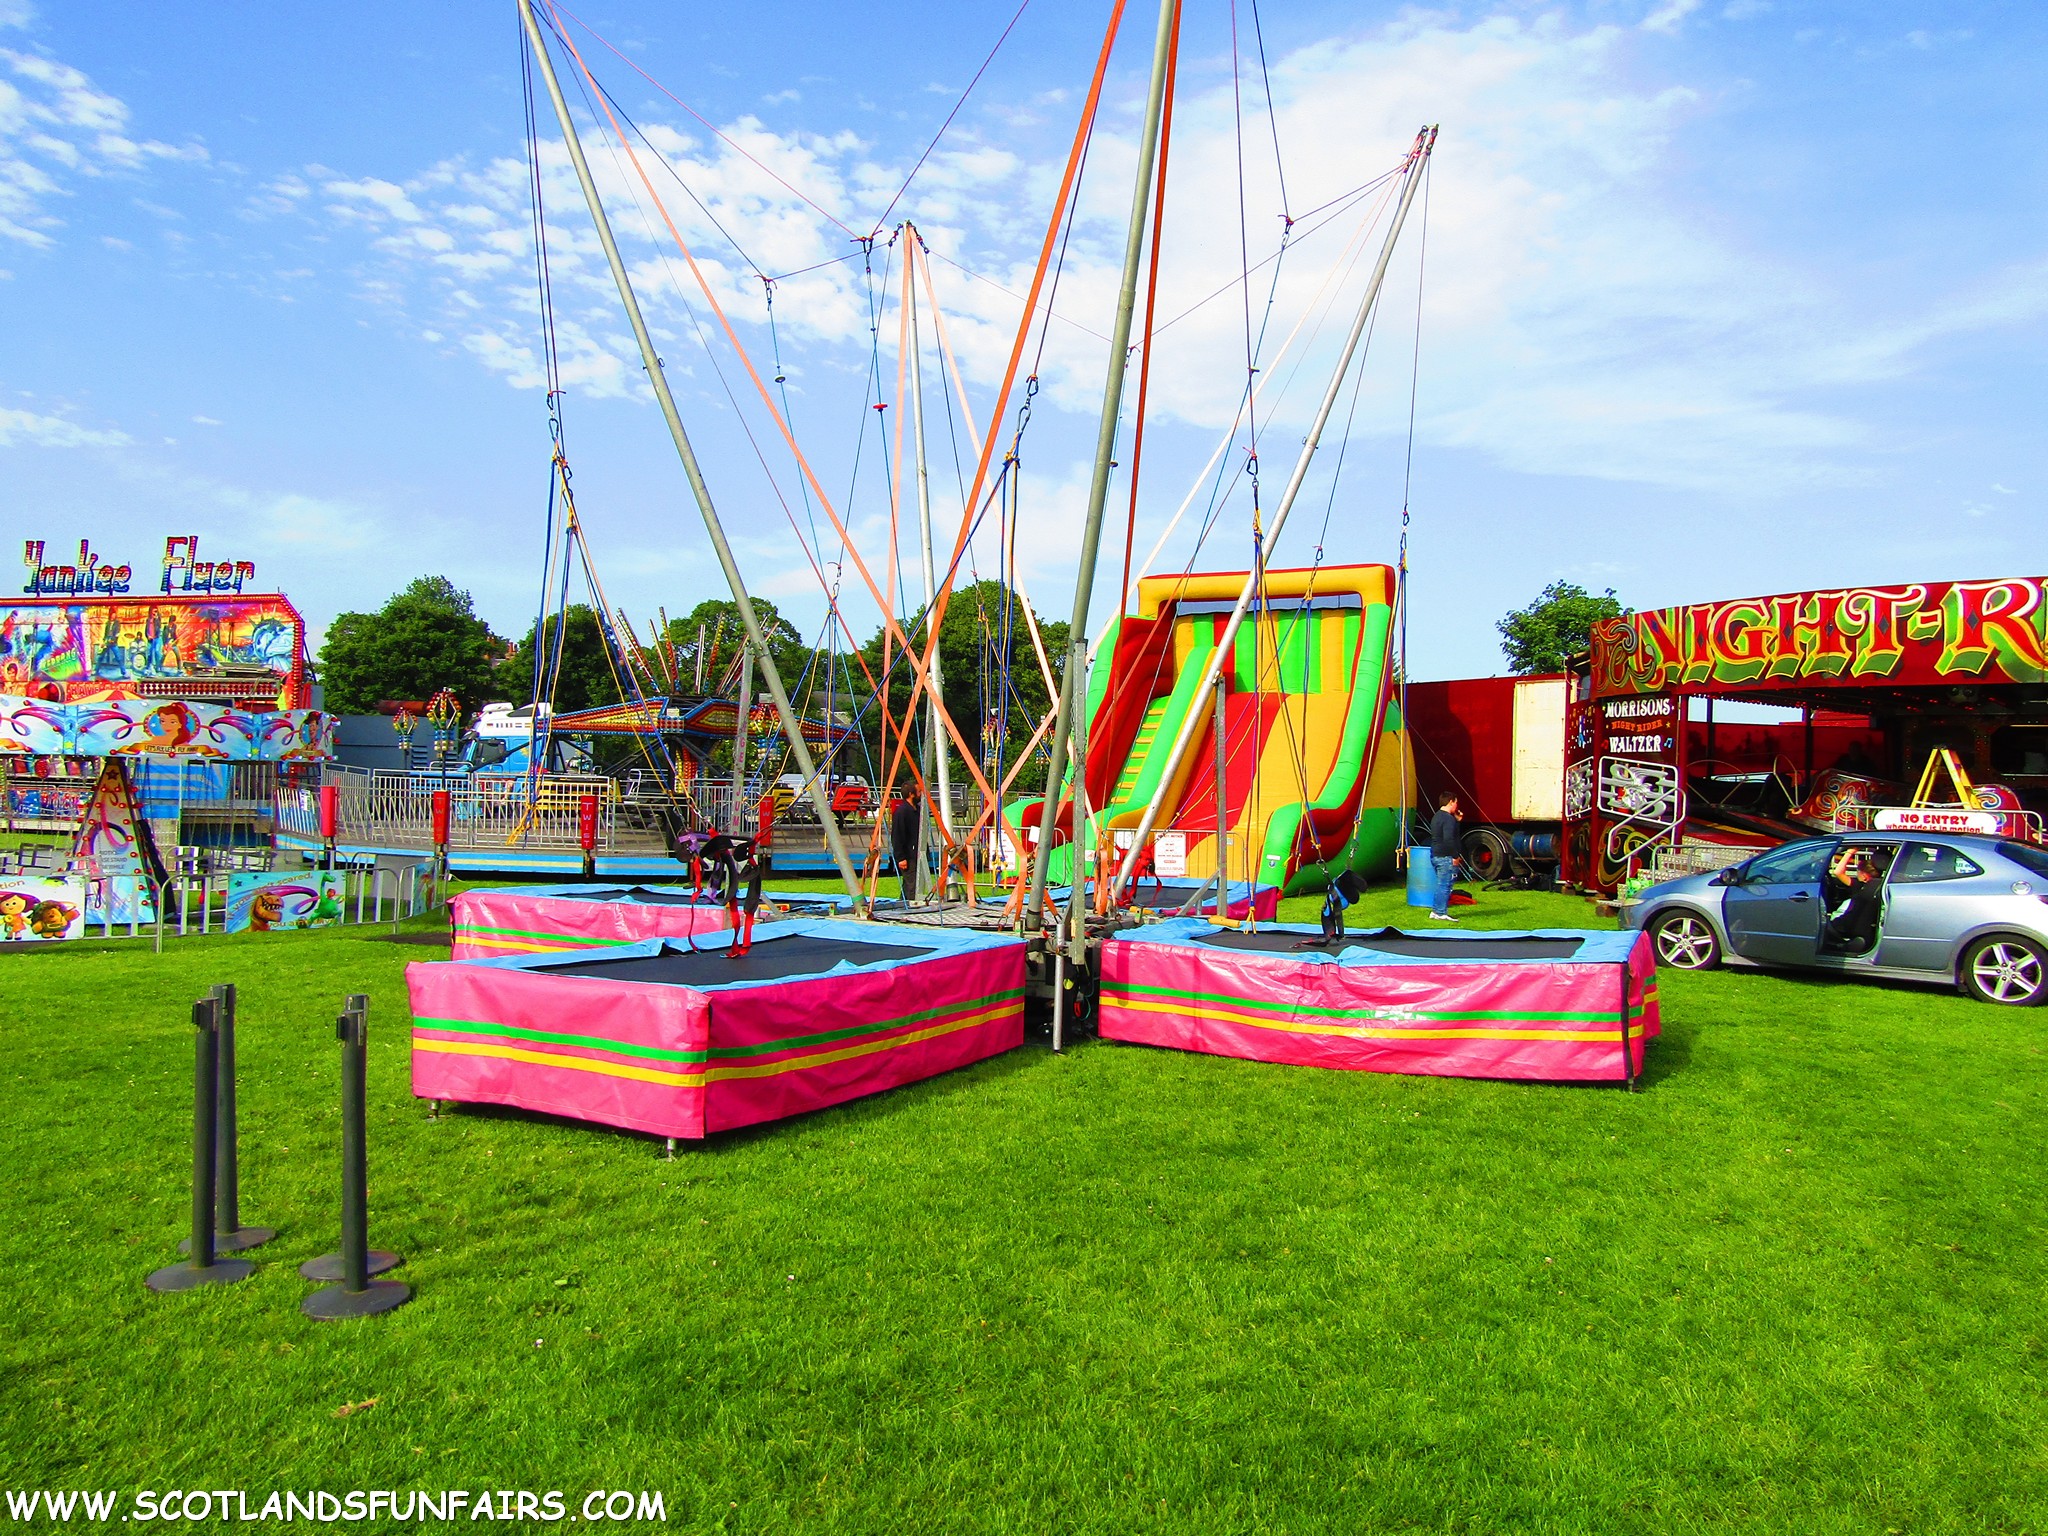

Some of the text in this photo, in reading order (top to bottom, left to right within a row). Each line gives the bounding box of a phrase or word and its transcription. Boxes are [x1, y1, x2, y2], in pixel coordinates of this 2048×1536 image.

[24, 535, 255, 593] Yankee Flyer
[1626, 578, 2048, 692] NIGHT-R
[1605, 698, 1671, 718] MORRISONS
[1611, 719, 1663, 732] NIGHT RIDER
[1609, 735, 1662, 753] WALTZER
[581, 802, 593, 847] TWIST
[1900, 814, 1968, 825] NO ENTRY
